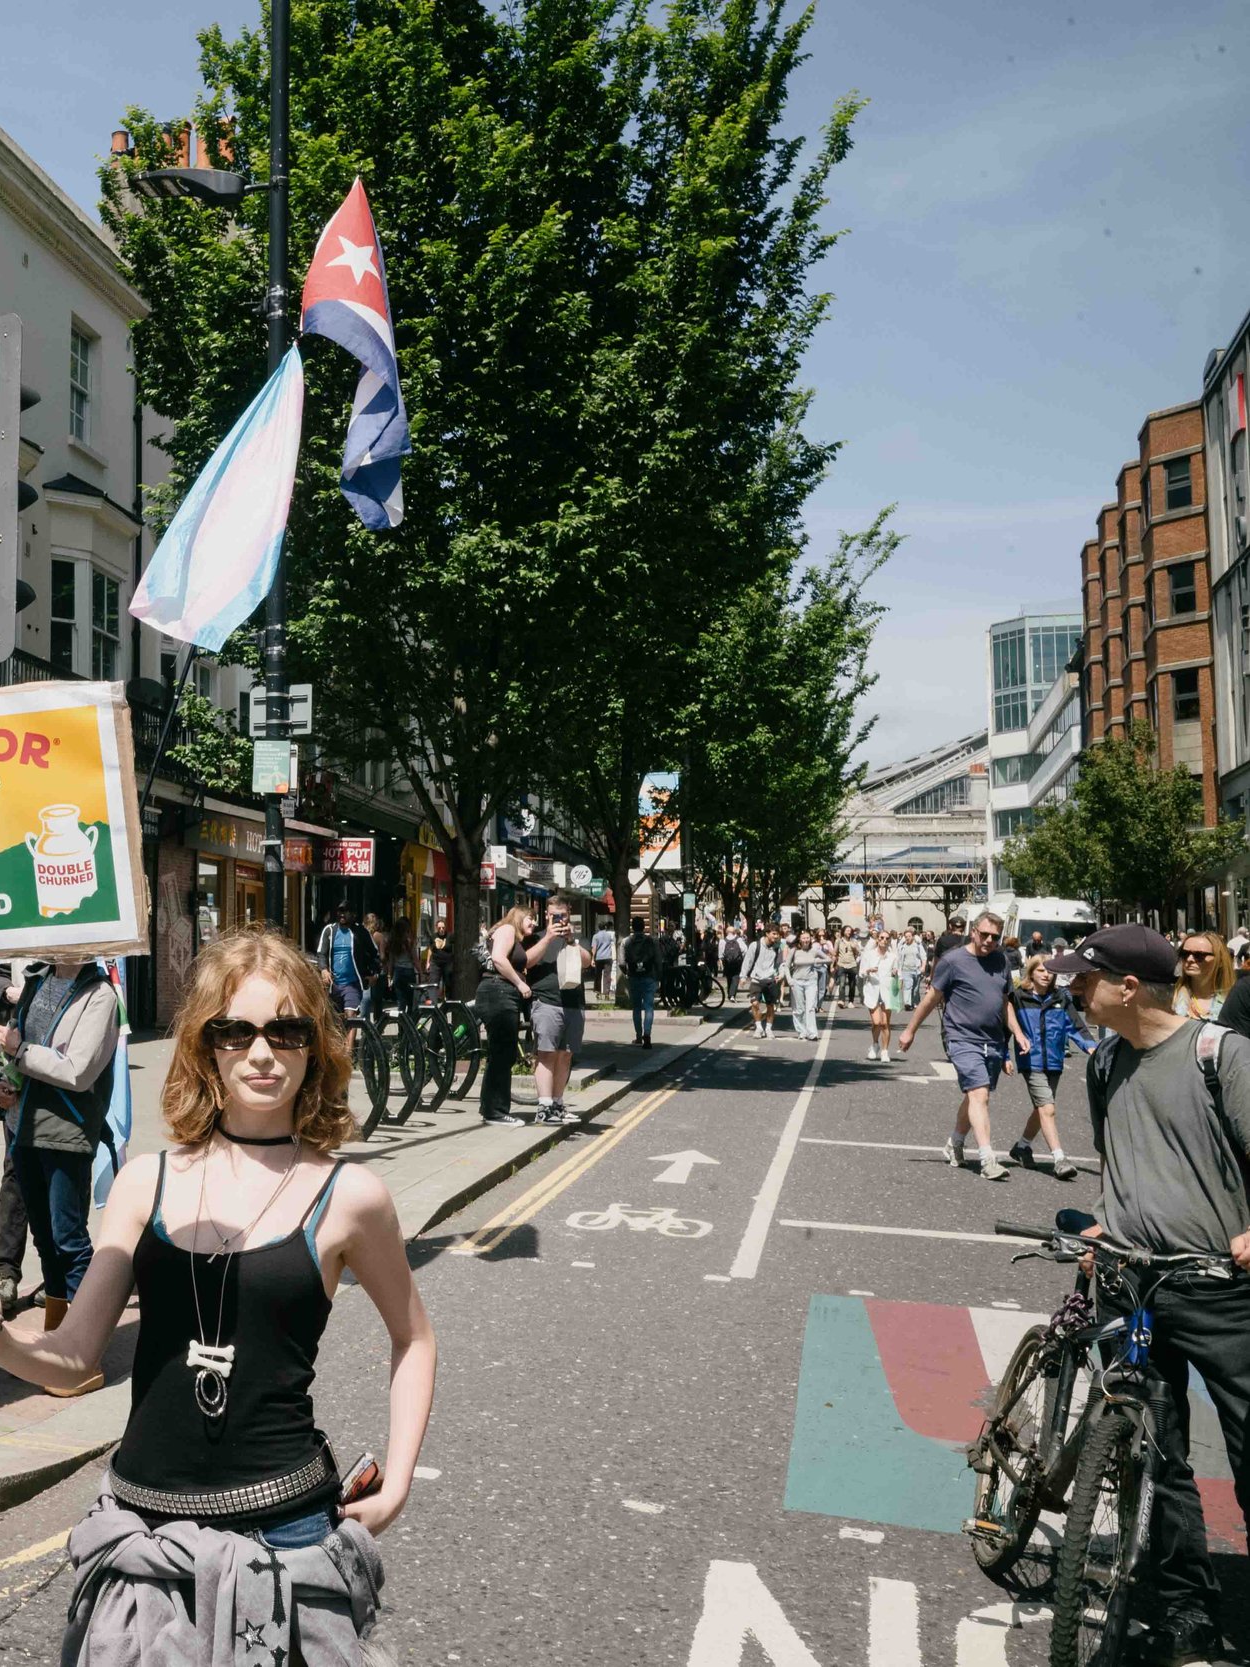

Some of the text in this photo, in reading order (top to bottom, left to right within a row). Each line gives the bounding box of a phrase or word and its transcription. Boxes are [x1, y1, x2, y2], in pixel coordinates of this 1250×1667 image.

[346, 847, 371, 859] POT
[37, 859, 93, 876] DOUBLE
[38, 870, 94, 887] CHURNED
